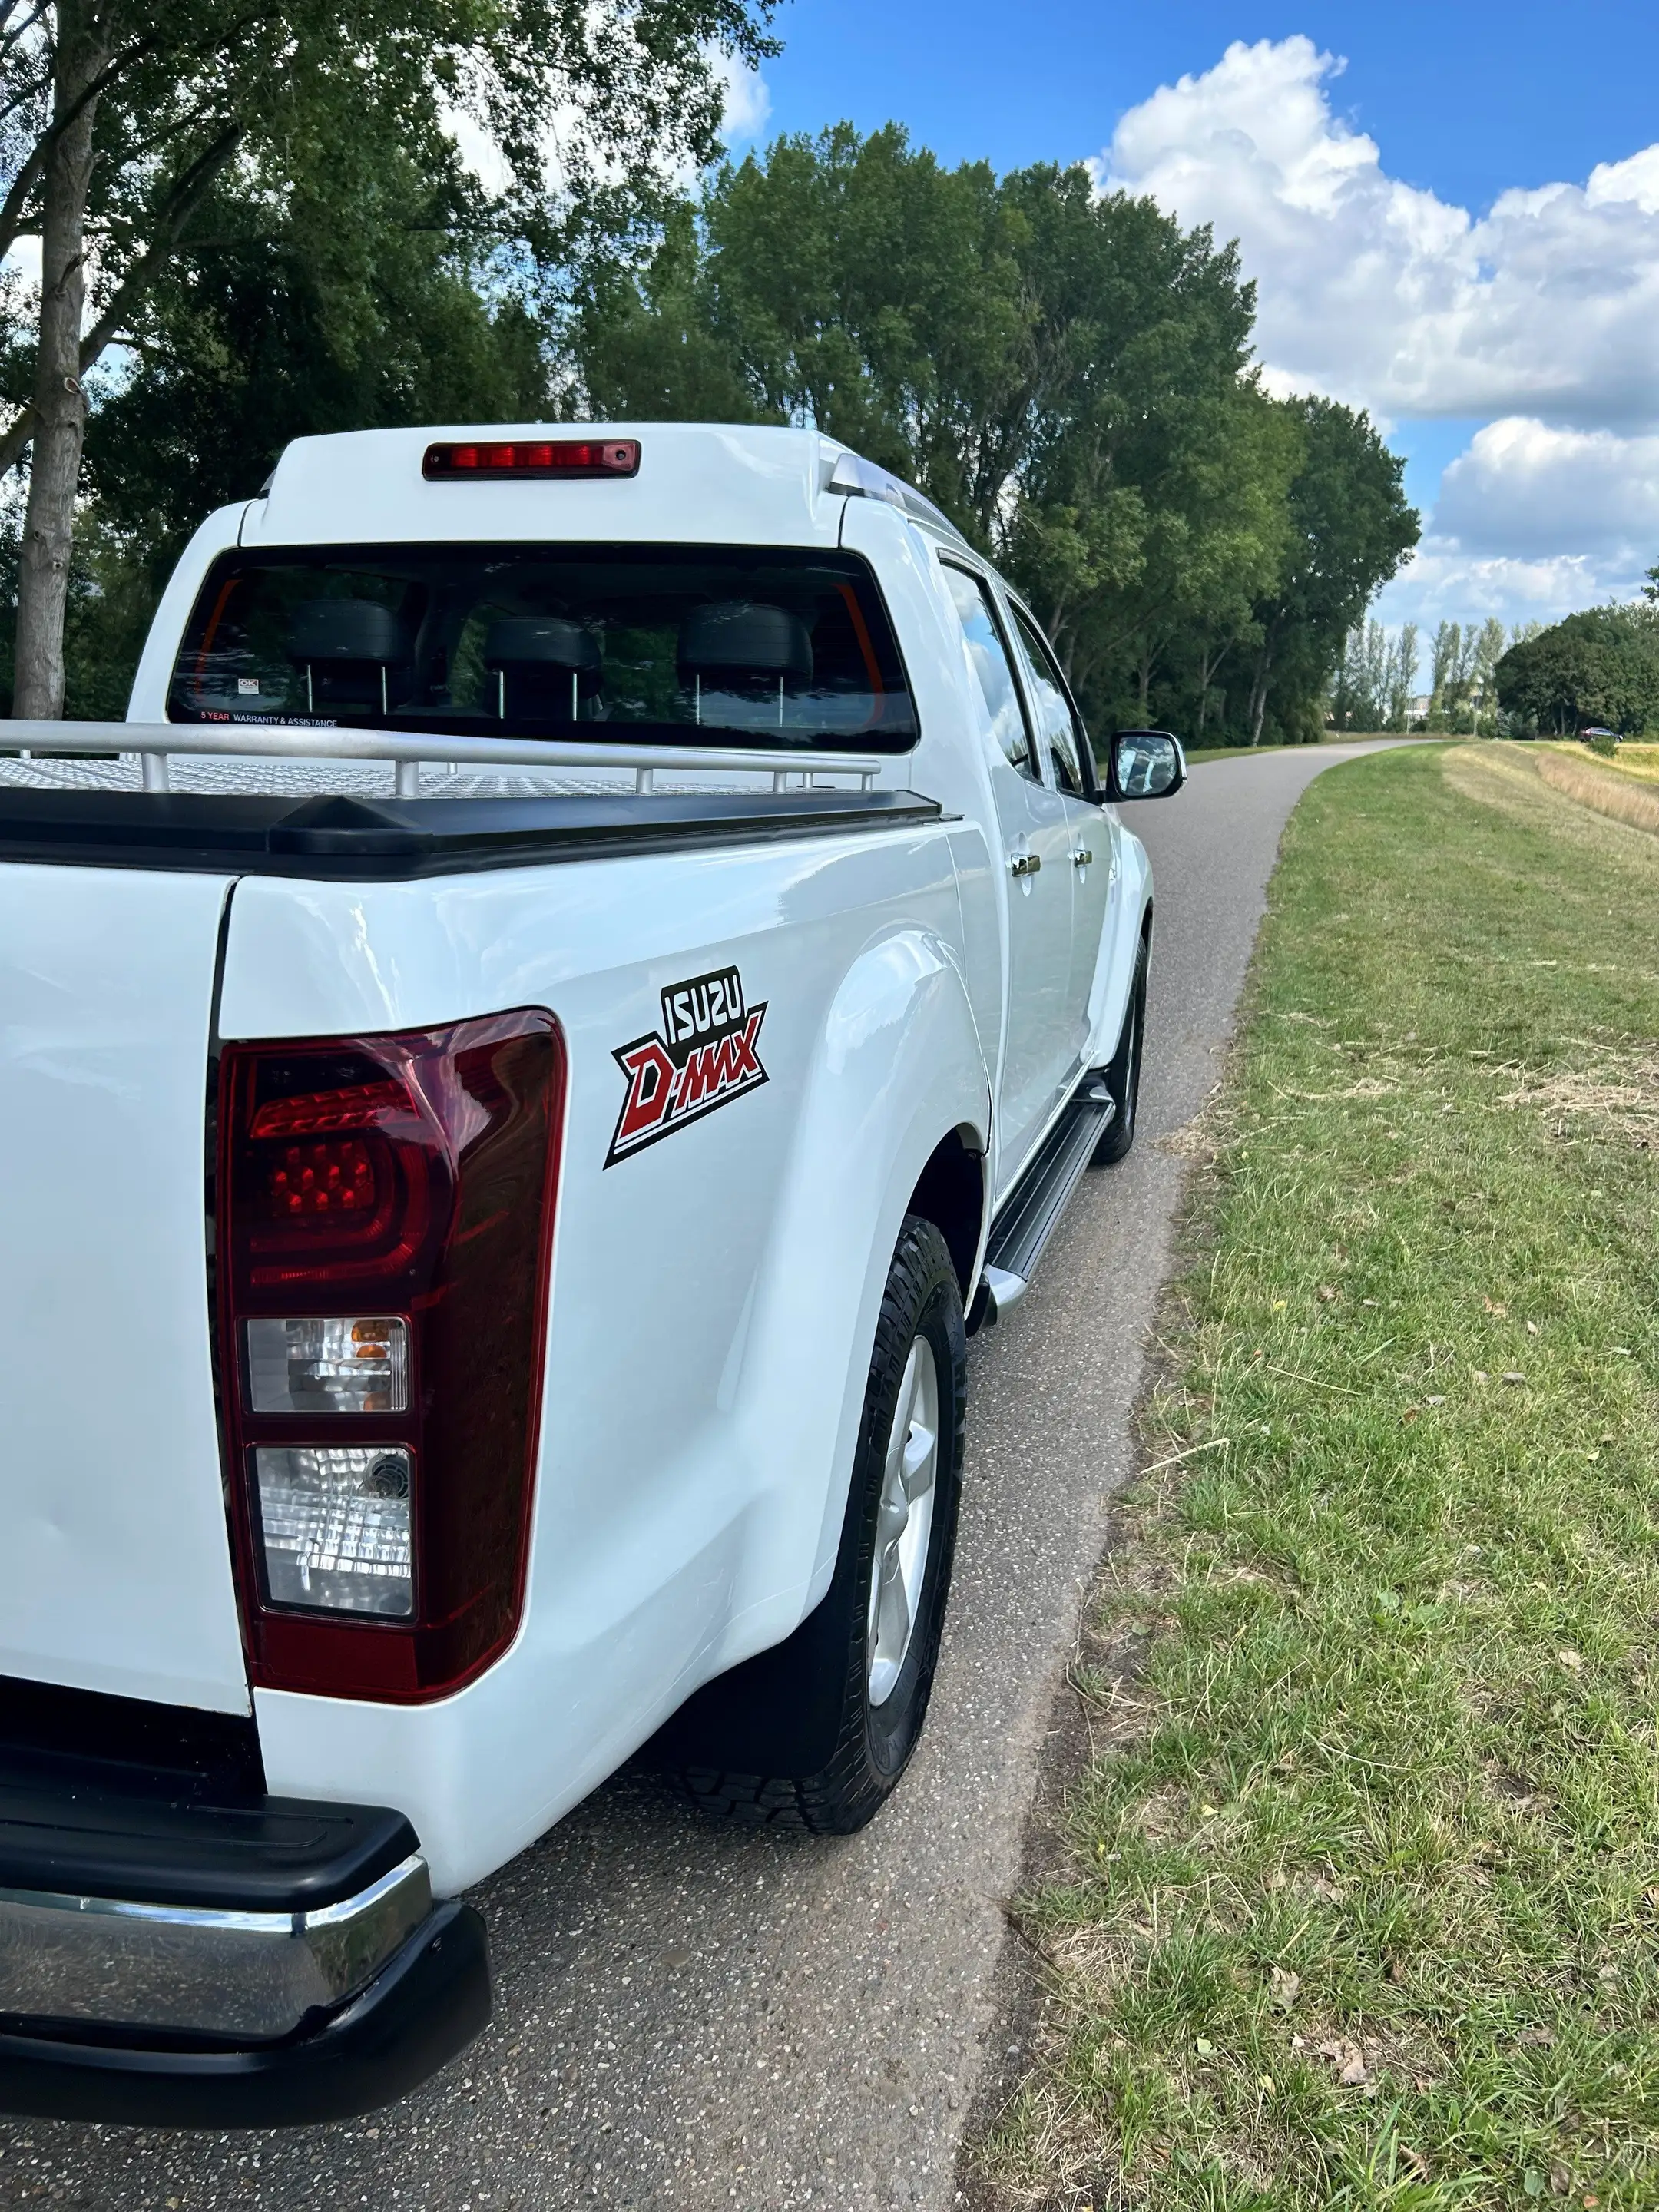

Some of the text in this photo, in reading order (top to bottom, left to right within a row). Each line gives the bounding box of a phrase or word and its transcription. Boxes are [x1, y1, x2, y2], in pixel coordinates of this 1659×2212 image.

[207, 711, 230, 720] YEAR
[233, 714, 279, 724] WARRANTY
[280, 717, 286, 725] &
[287, 718, 338, 727] ASSISTANCE
[664, 974, 742, 1045] ISUZU
[614, 1010, 763, 1147] D-MAX
